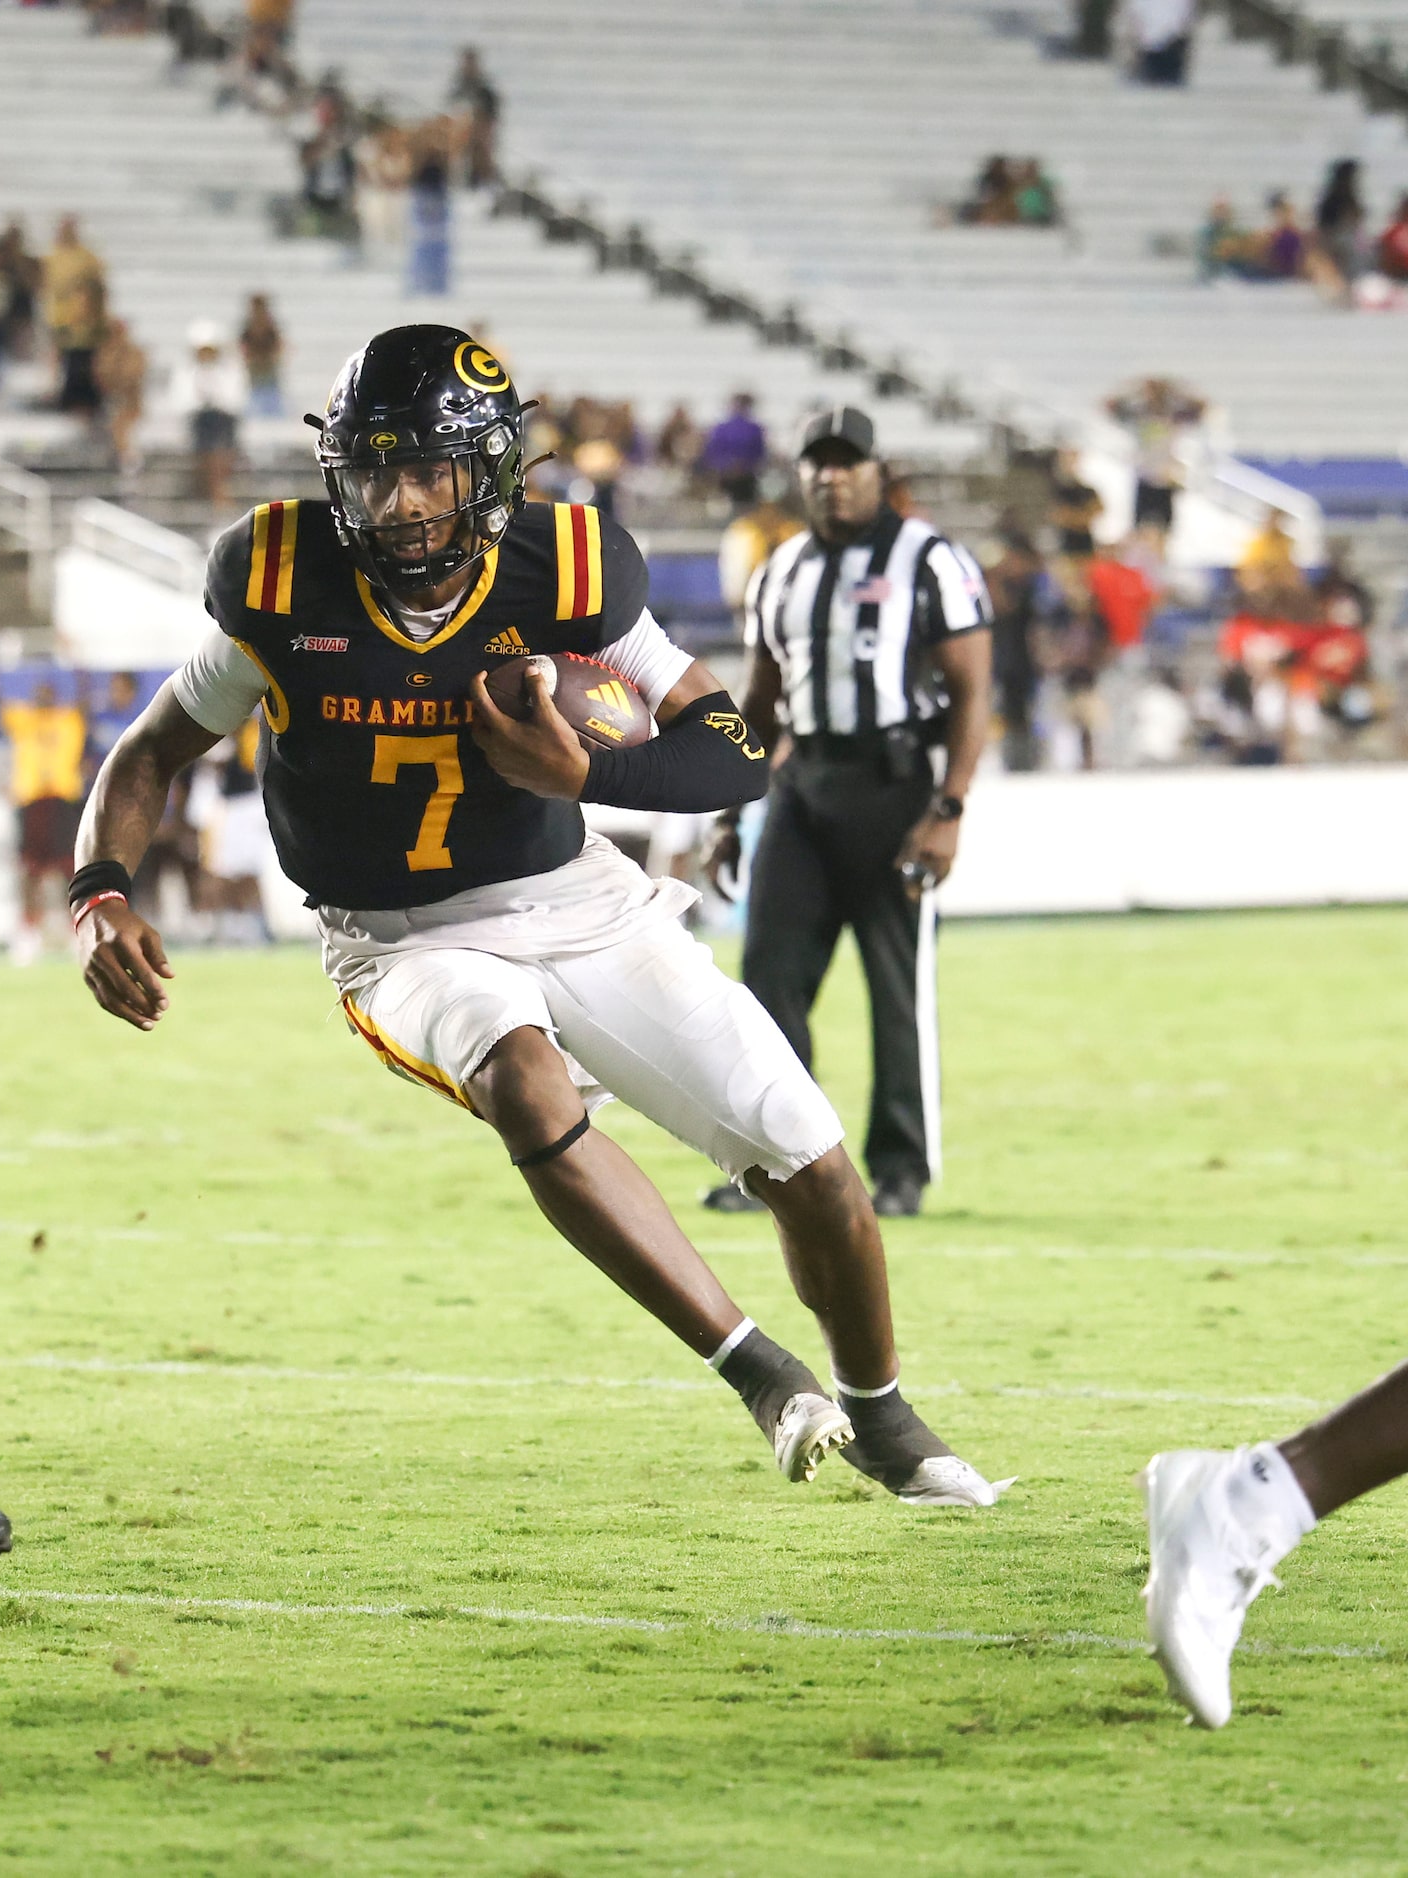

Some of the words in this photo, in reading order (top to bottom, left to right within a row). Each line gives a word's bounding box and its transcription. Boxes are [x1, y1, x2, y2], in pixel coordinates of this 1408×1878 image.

[306, 637, 348, 652] SWAC
[484, 643, 531, 655] adidas
[584, 716, 626, 743] DIME
[370, 734, 465, 872] 7
